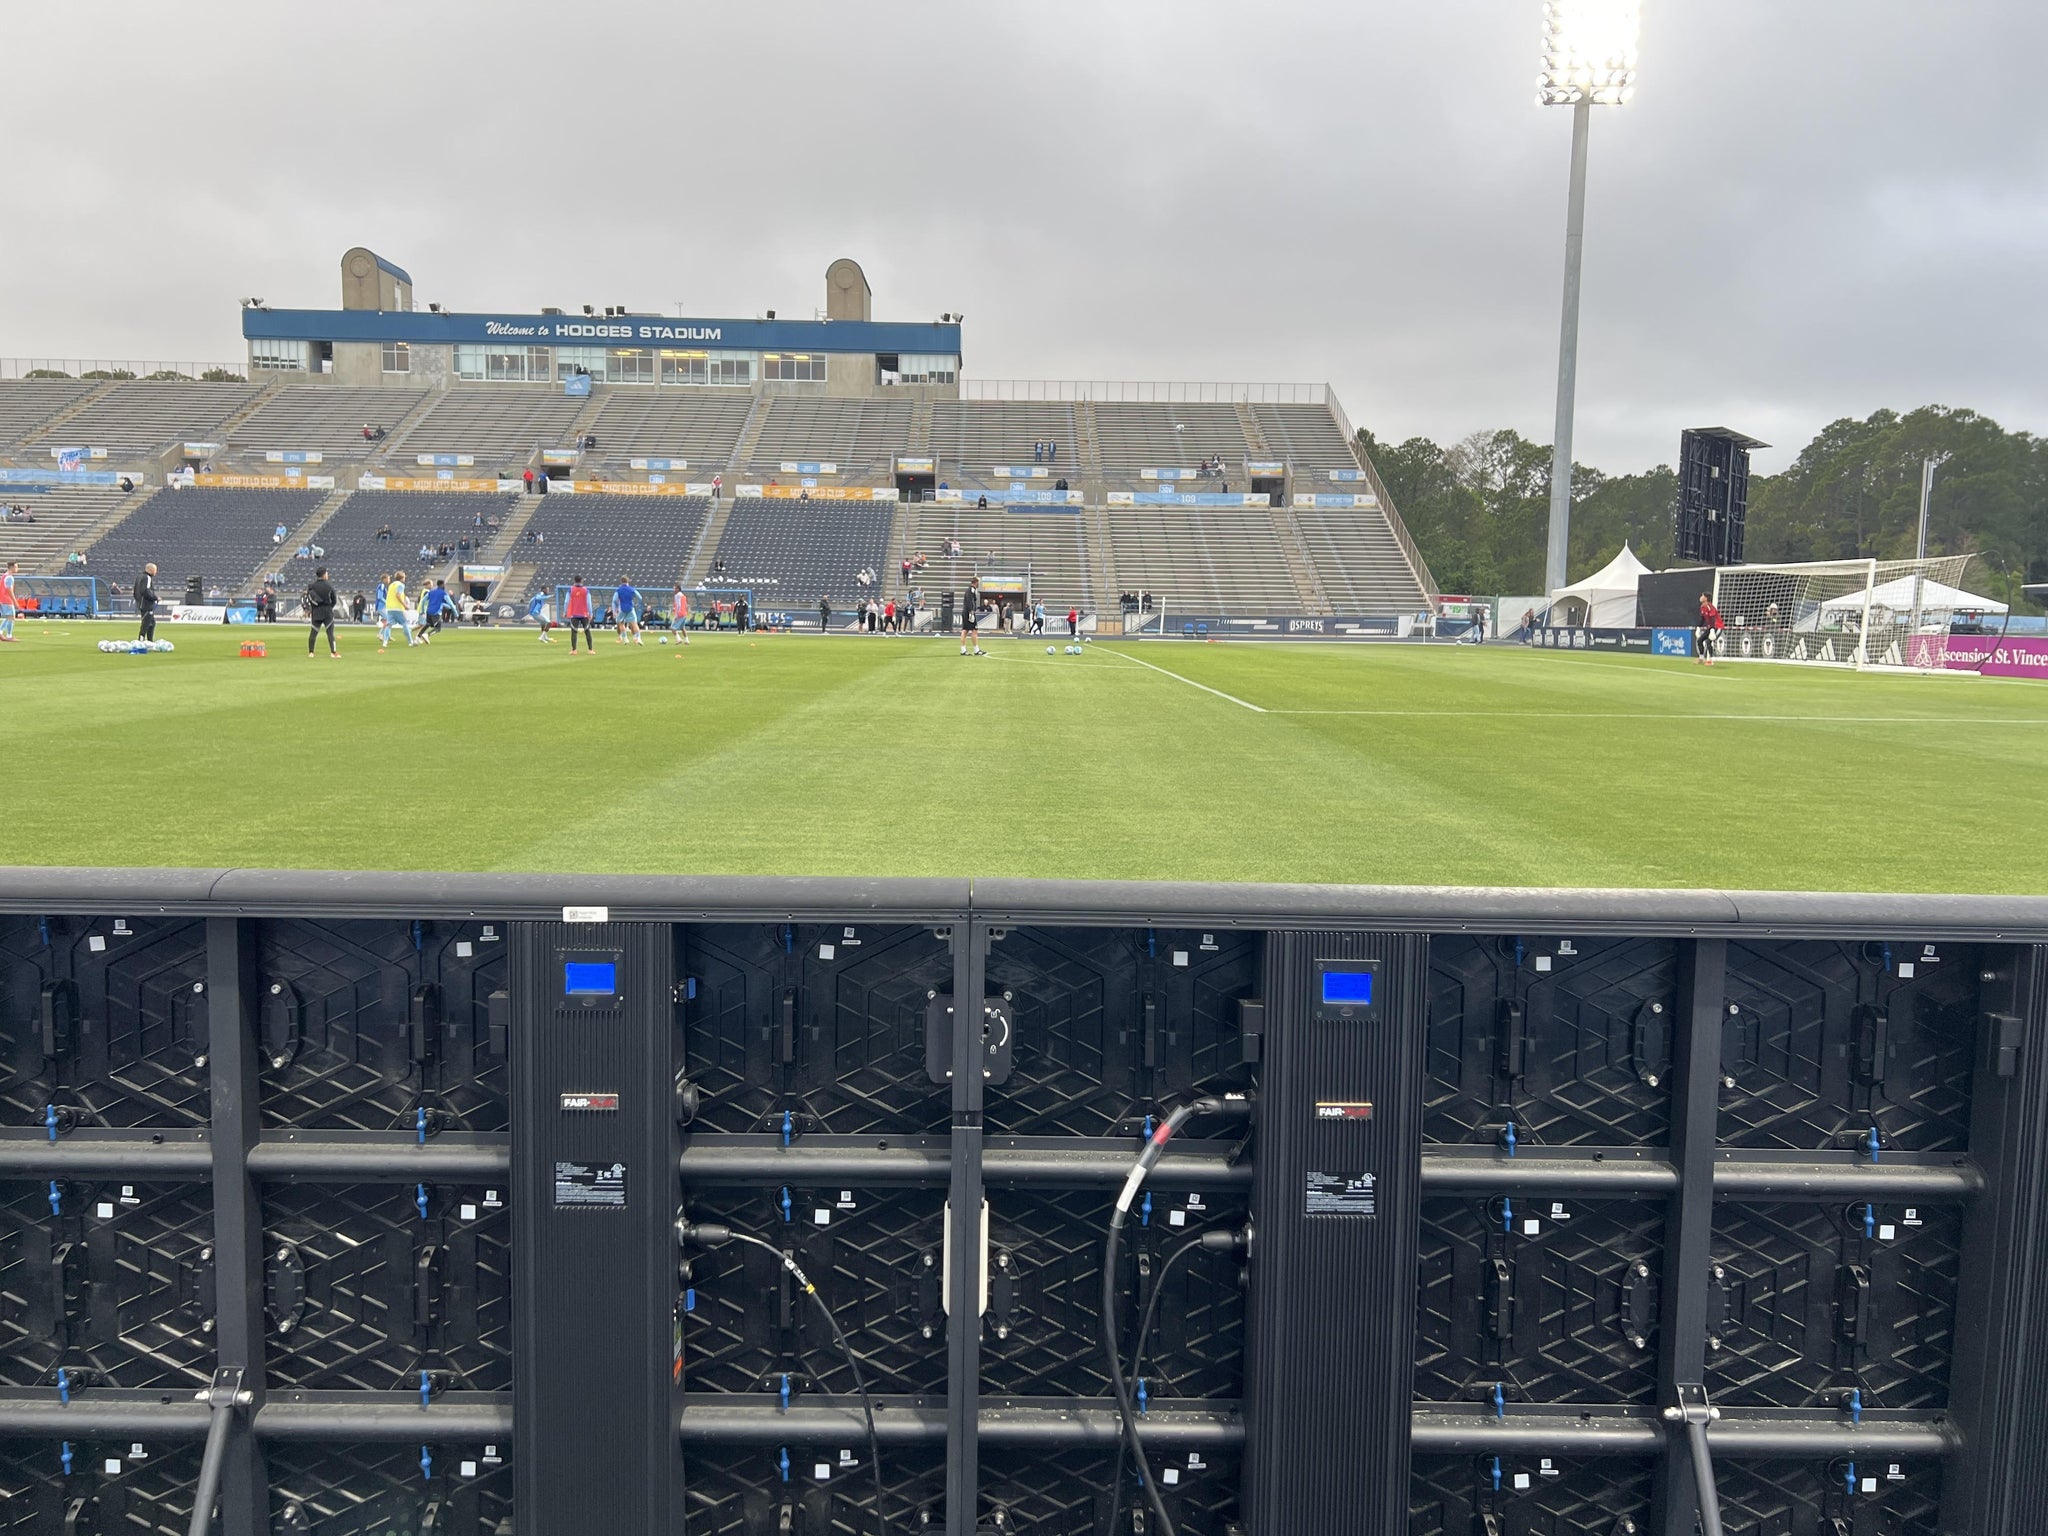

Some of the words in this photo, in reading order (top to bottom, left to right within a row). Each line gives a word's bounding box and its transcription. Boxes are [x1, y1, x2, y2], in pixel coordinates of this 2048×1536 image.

[485, 321, 535, 336] Welcome
[539, 325, 550, 337] to
[556, 324, 633, 338] HODGES
[639, 326, 721, 340] STADIUM
[222, 476, 260, 486] MIDFIELD
[260, 477, 280, 486] CLUB
[451, 481, 470, 490] CLUB
[601, 483, 639, 494] MIDFIELD
[639, 485, 659, 494] CLUB
[181, 608, 223, 622] Price.com
[1290, 619, 1324, 632] OSPREYS
[1937, 647, 1993, 663] Ascension
[1995, 648, 2011, 664] St.
